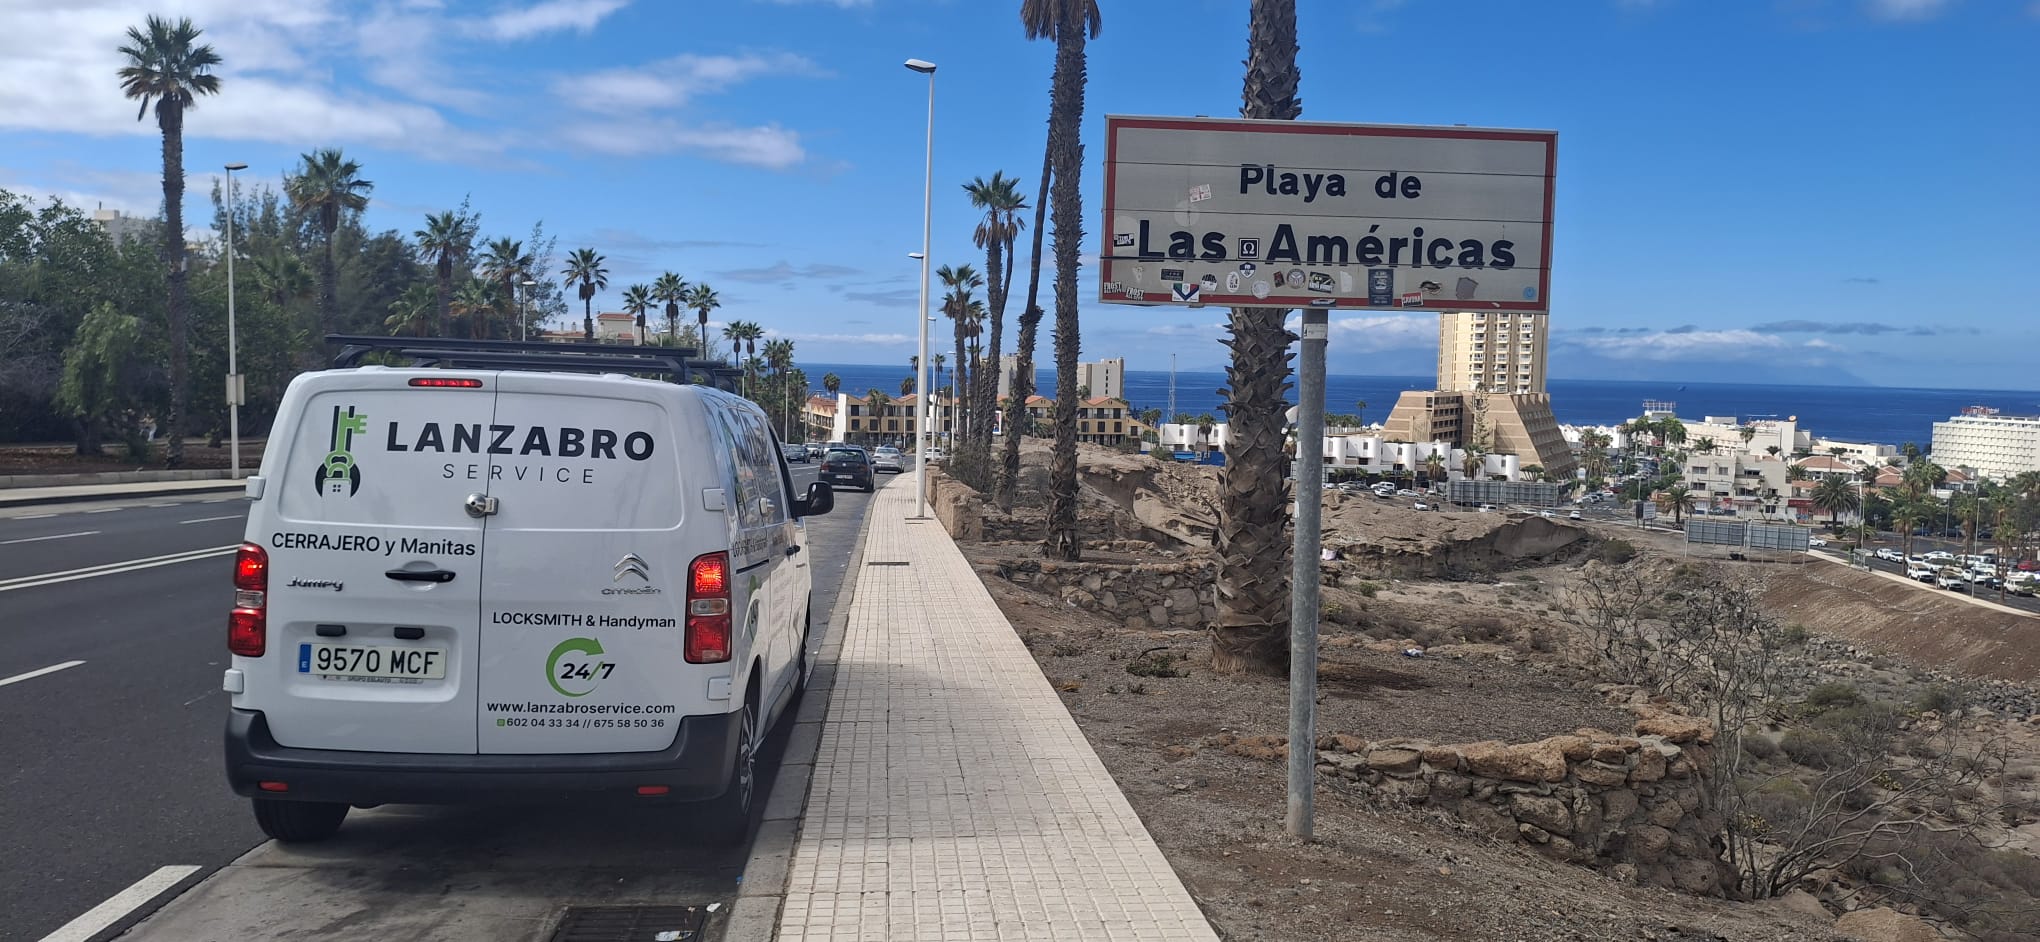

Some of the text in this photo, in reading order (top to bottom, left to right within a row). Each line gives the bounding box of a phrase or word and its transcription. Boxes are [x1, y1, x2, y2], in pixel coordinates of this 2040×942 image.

[1240, 164, 1347, 203] Playa
[1374, 170, 1422, 199] de
[1139, 220, 1516, 270] Las Américas
[386, 421, 655, 462] LANZABRO
[442, 463, 594, 484] SERVICE
[272, 533, 476, 556] CERRAJERO y Manitas
[493, 612, 676, 630] LOCKSMITH & Handyman
[317, 648, 439, 675] 9570 MCF
[560, 661, 616, 681] 24/7
[487, 702, 675, 714] www.lanzabroservice.com
[506, 718, 528, 727] 602
[531, 718, 546, 727] 04
[548, 718, 563, 728] 33
[565, 719, 580, 728] 34
[594, 719, 614, 728] 675
[617, 719, 632, 728] 58
[634, 719, 648, 728] 50
[650, 719, 665, 728] 36
